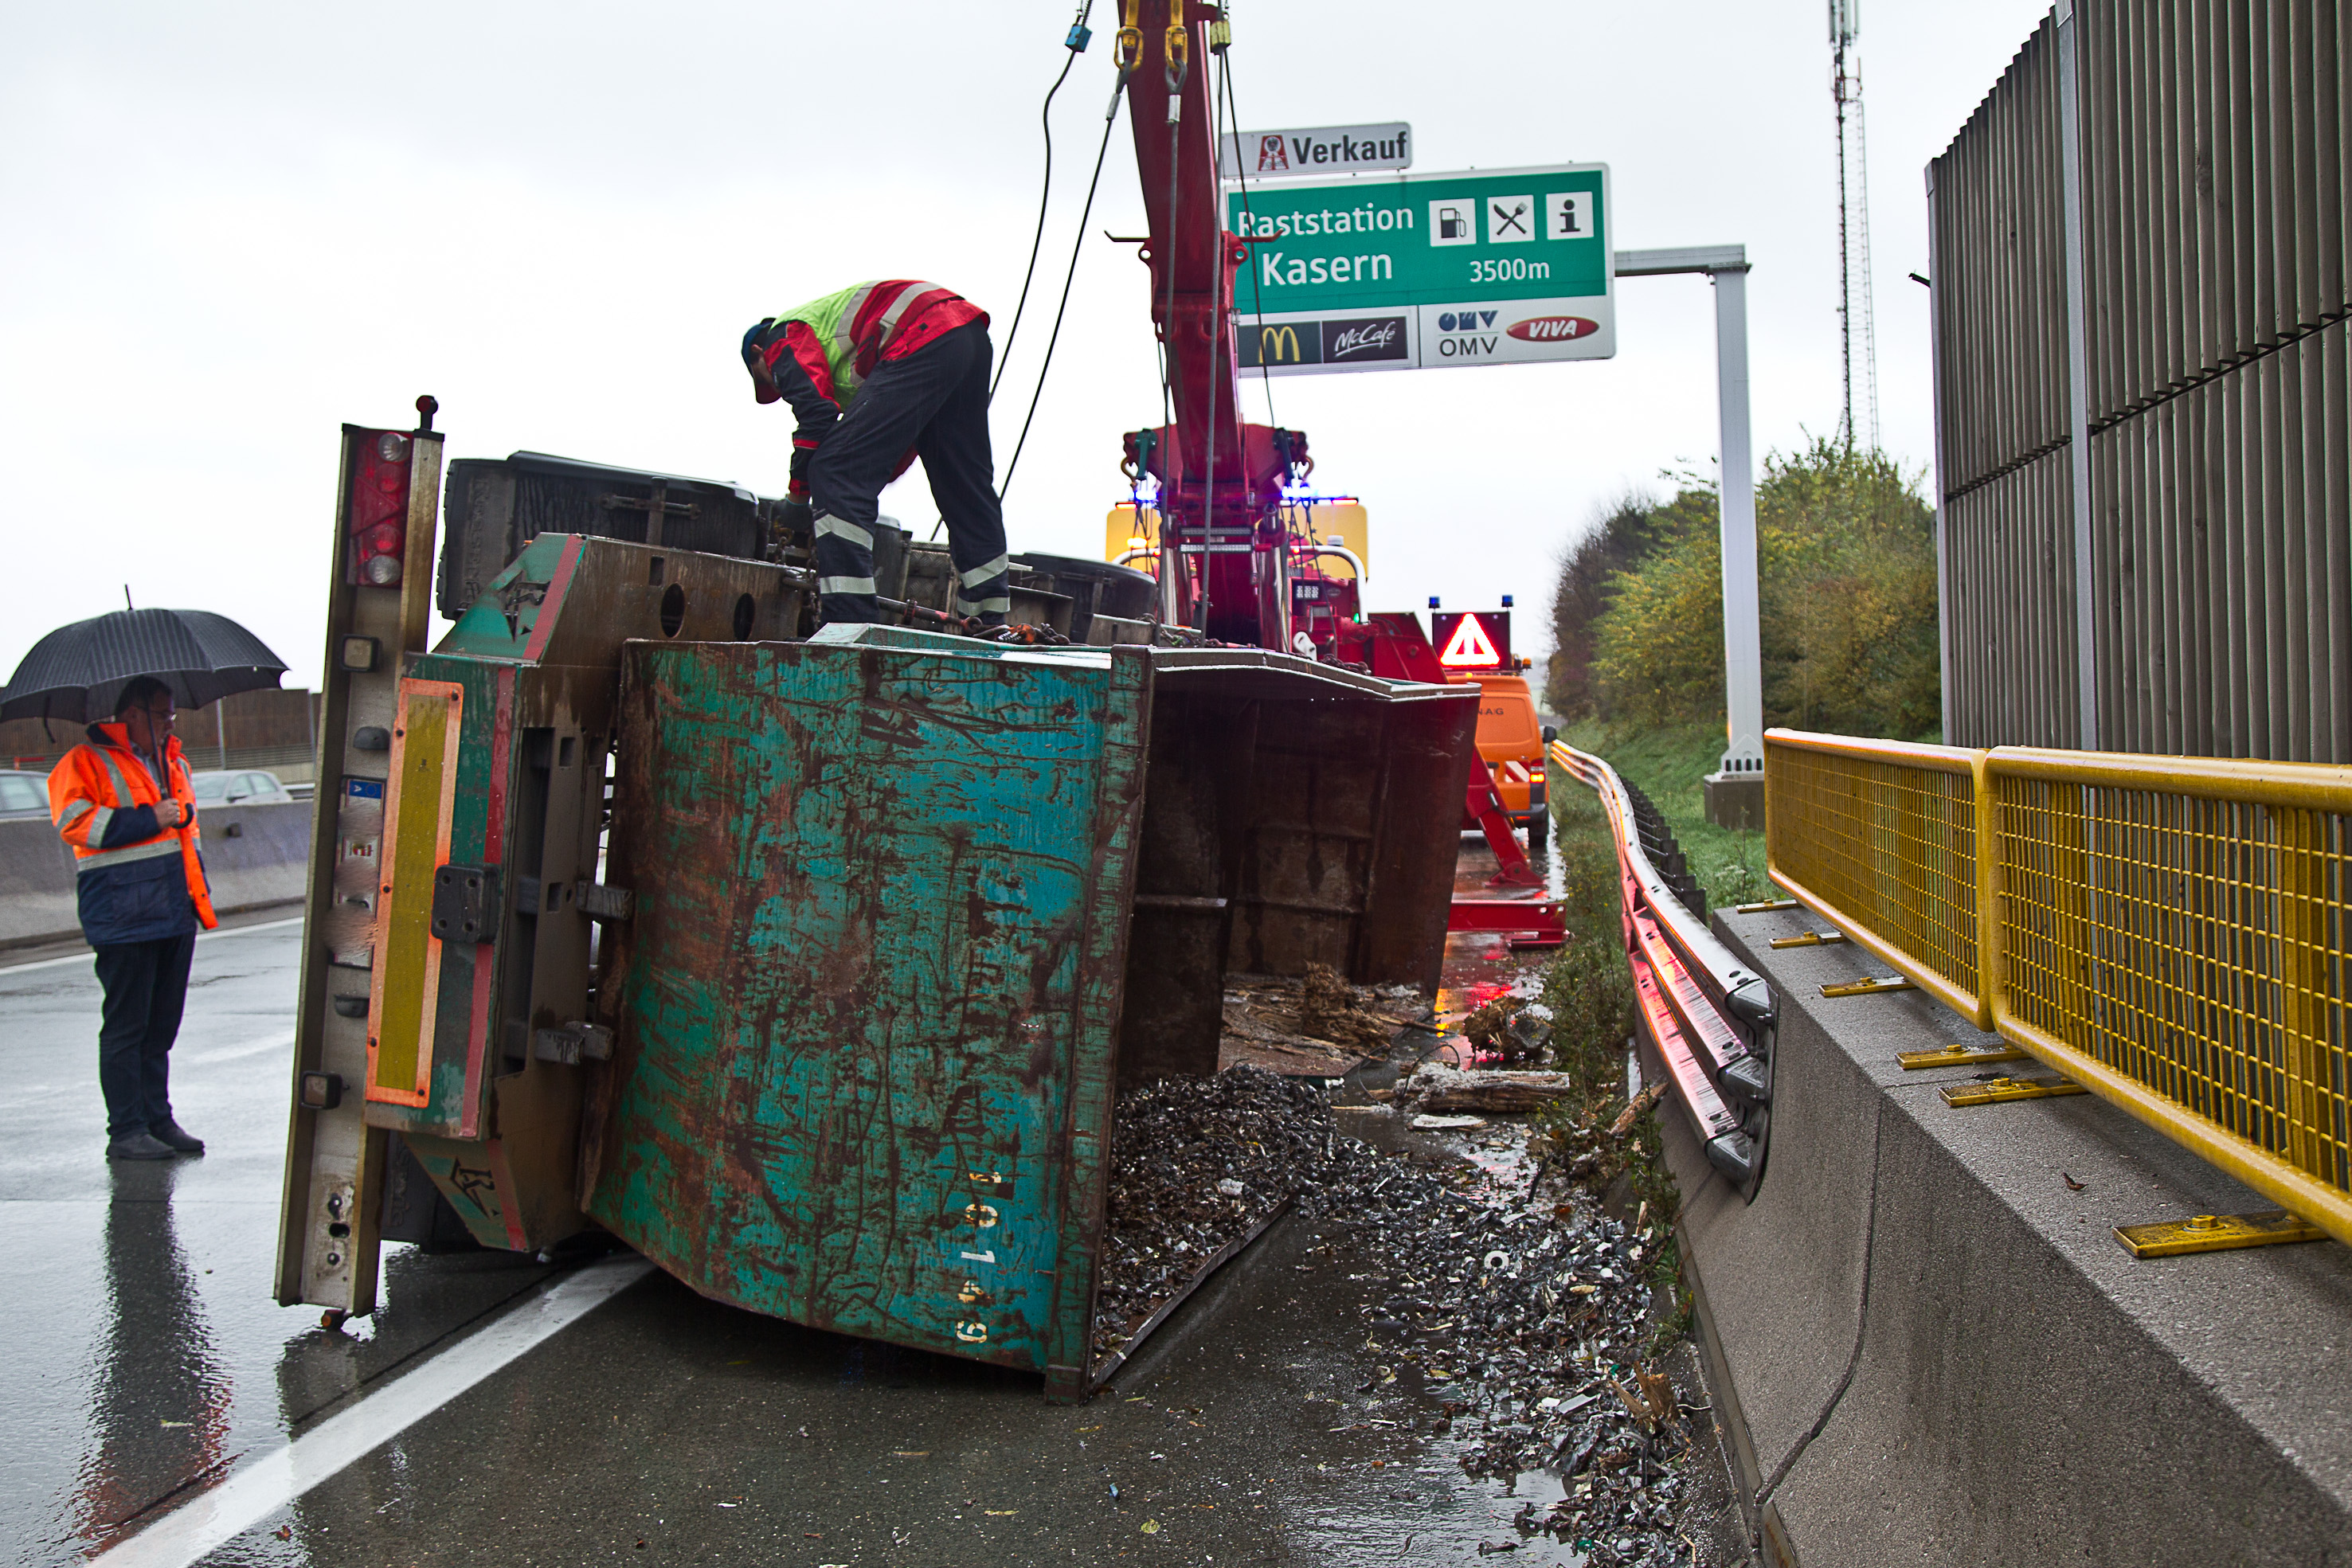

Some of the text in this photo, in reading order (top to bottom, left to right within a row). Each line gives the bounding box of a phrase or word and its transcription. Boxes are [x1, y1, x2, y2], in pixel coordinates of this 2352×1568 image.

[1293, 131, 1407, 164] Verkauf
[1238, 202, 1414, 237] Raststation
[1262, 252, 1393, 286] Kasern
[1470, 259, 1550, 283] 3500m
[1529, 320, 1578, 338] VIVA
[1439, 336, 1498, 357] OMV
